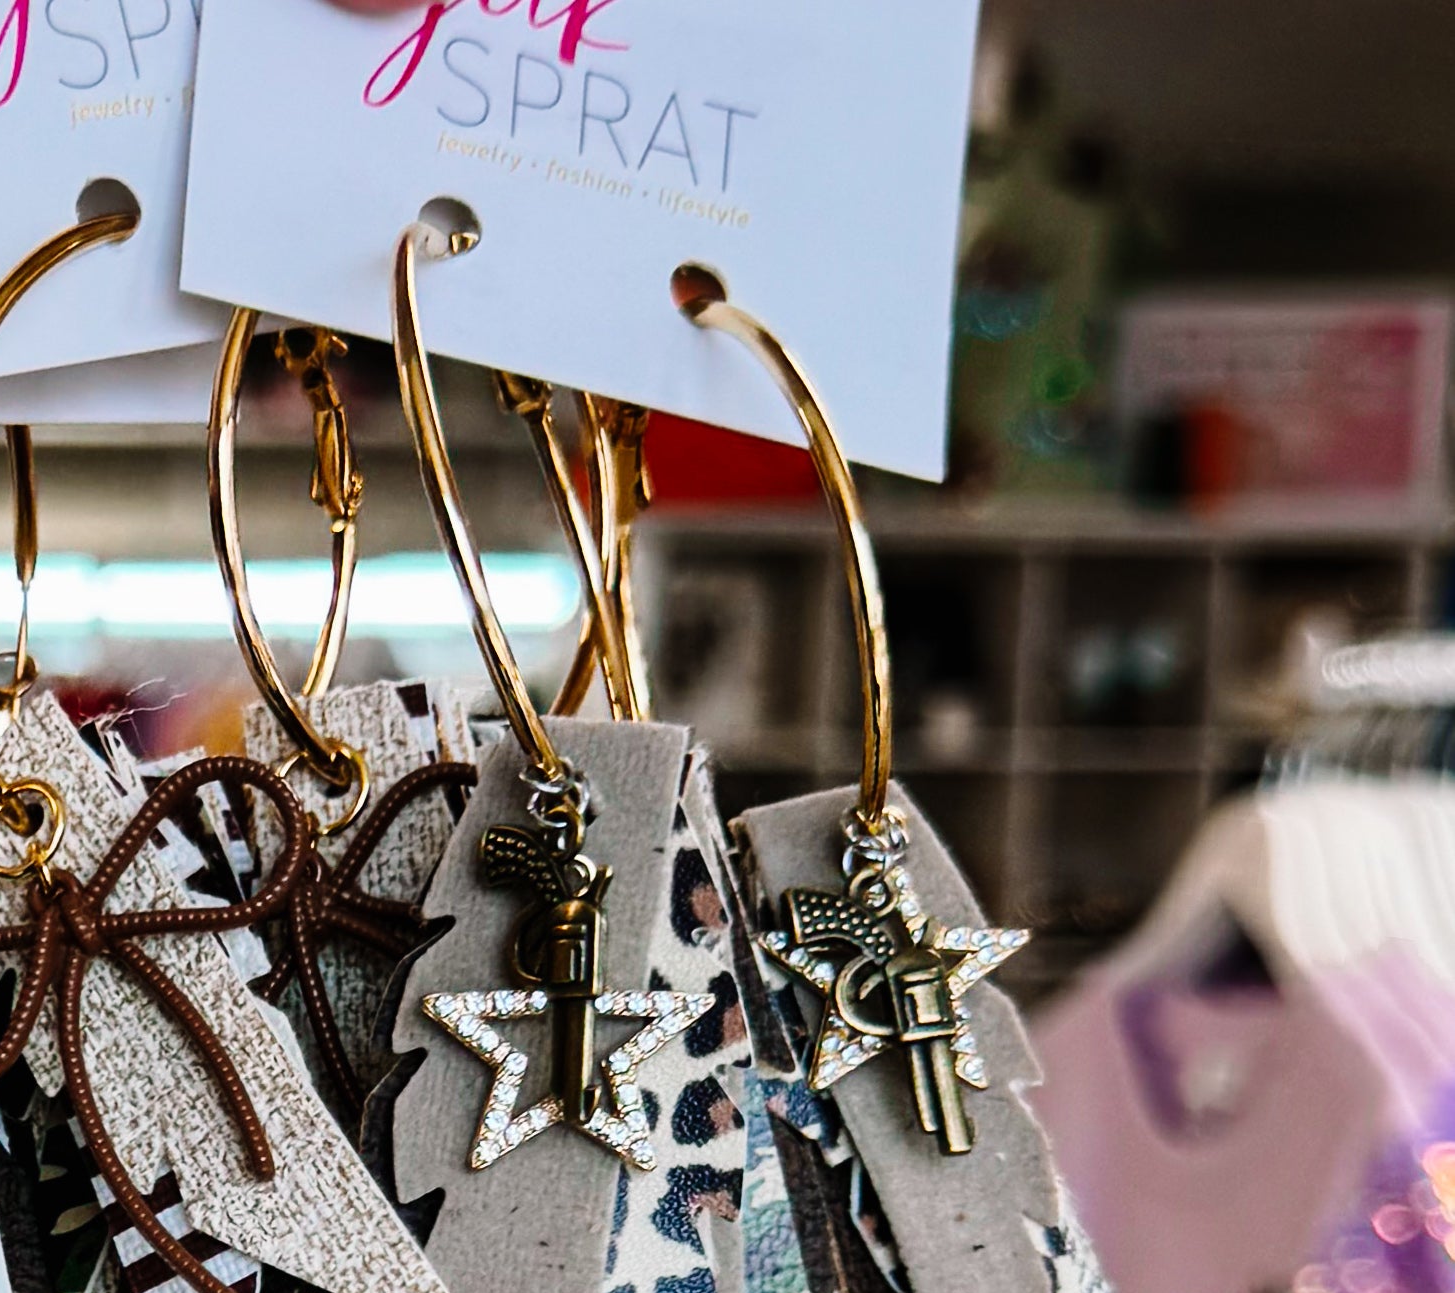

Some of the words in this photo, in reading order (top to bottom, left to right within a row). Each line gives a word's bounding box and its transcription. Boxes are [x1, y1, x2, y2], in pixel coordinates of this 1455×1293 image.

[69, 95, 155, 130] jewelry
[436, 37, 760, 193] SPRAT
[436, 131, 521, 174] jewelry
[547, 158, 633, 198] fashion
[658, 187, 750, 229] lifestyle
